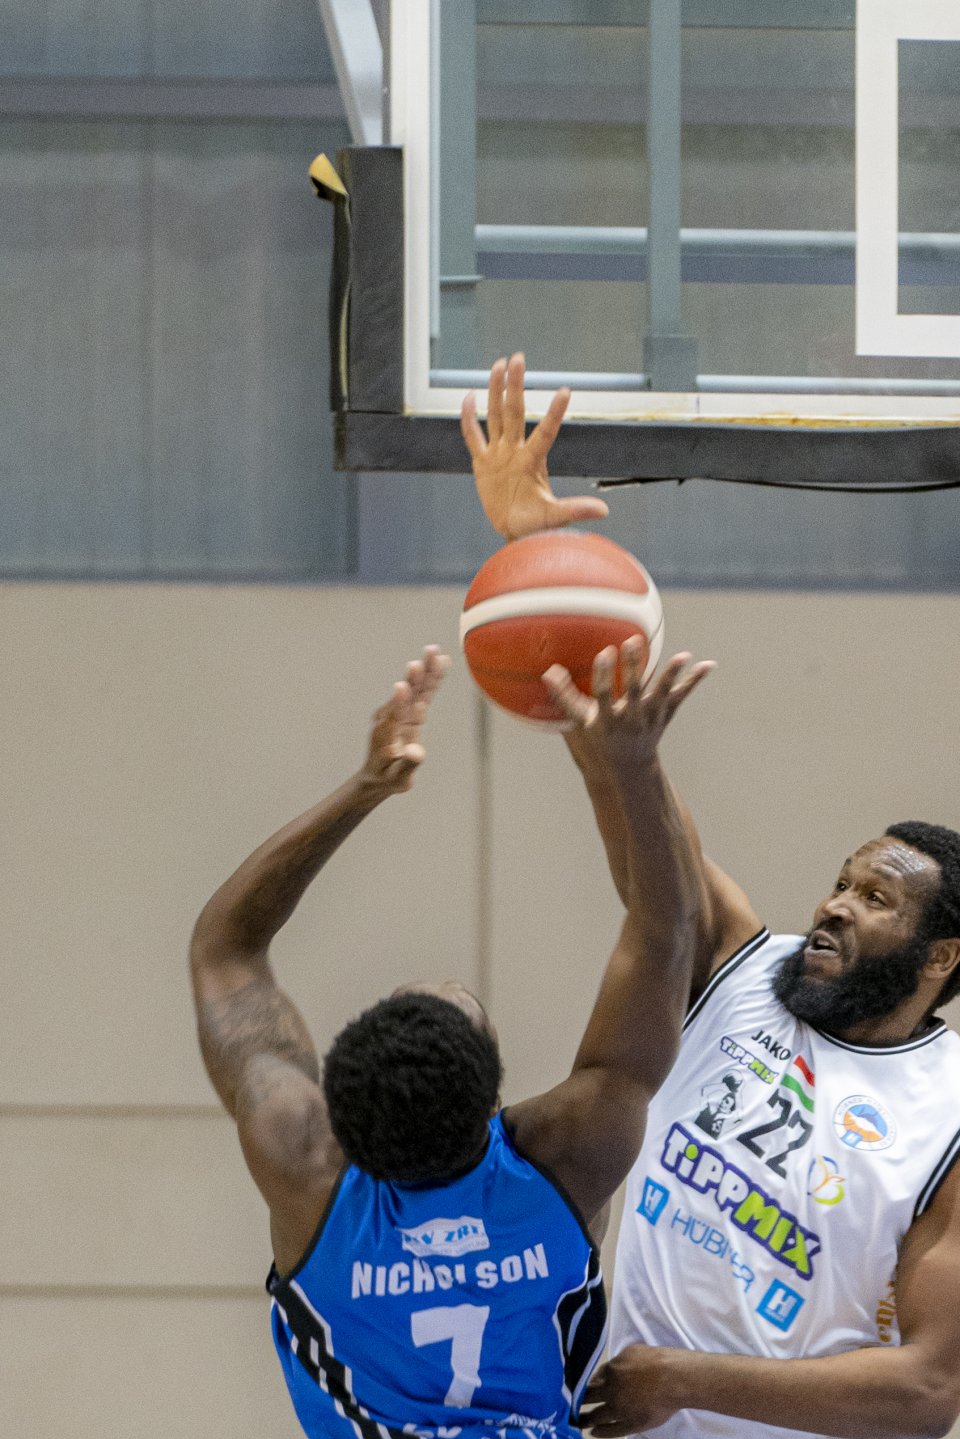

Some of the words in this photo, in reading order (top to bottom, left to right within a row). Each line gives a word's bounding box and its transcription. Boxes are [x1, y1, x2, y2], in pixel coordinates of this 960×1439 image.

[751, 1030, 791, 1060] JAKO
[736, 1088, 814, 1180] 22
[410, 1304, 490, 1408] 7
